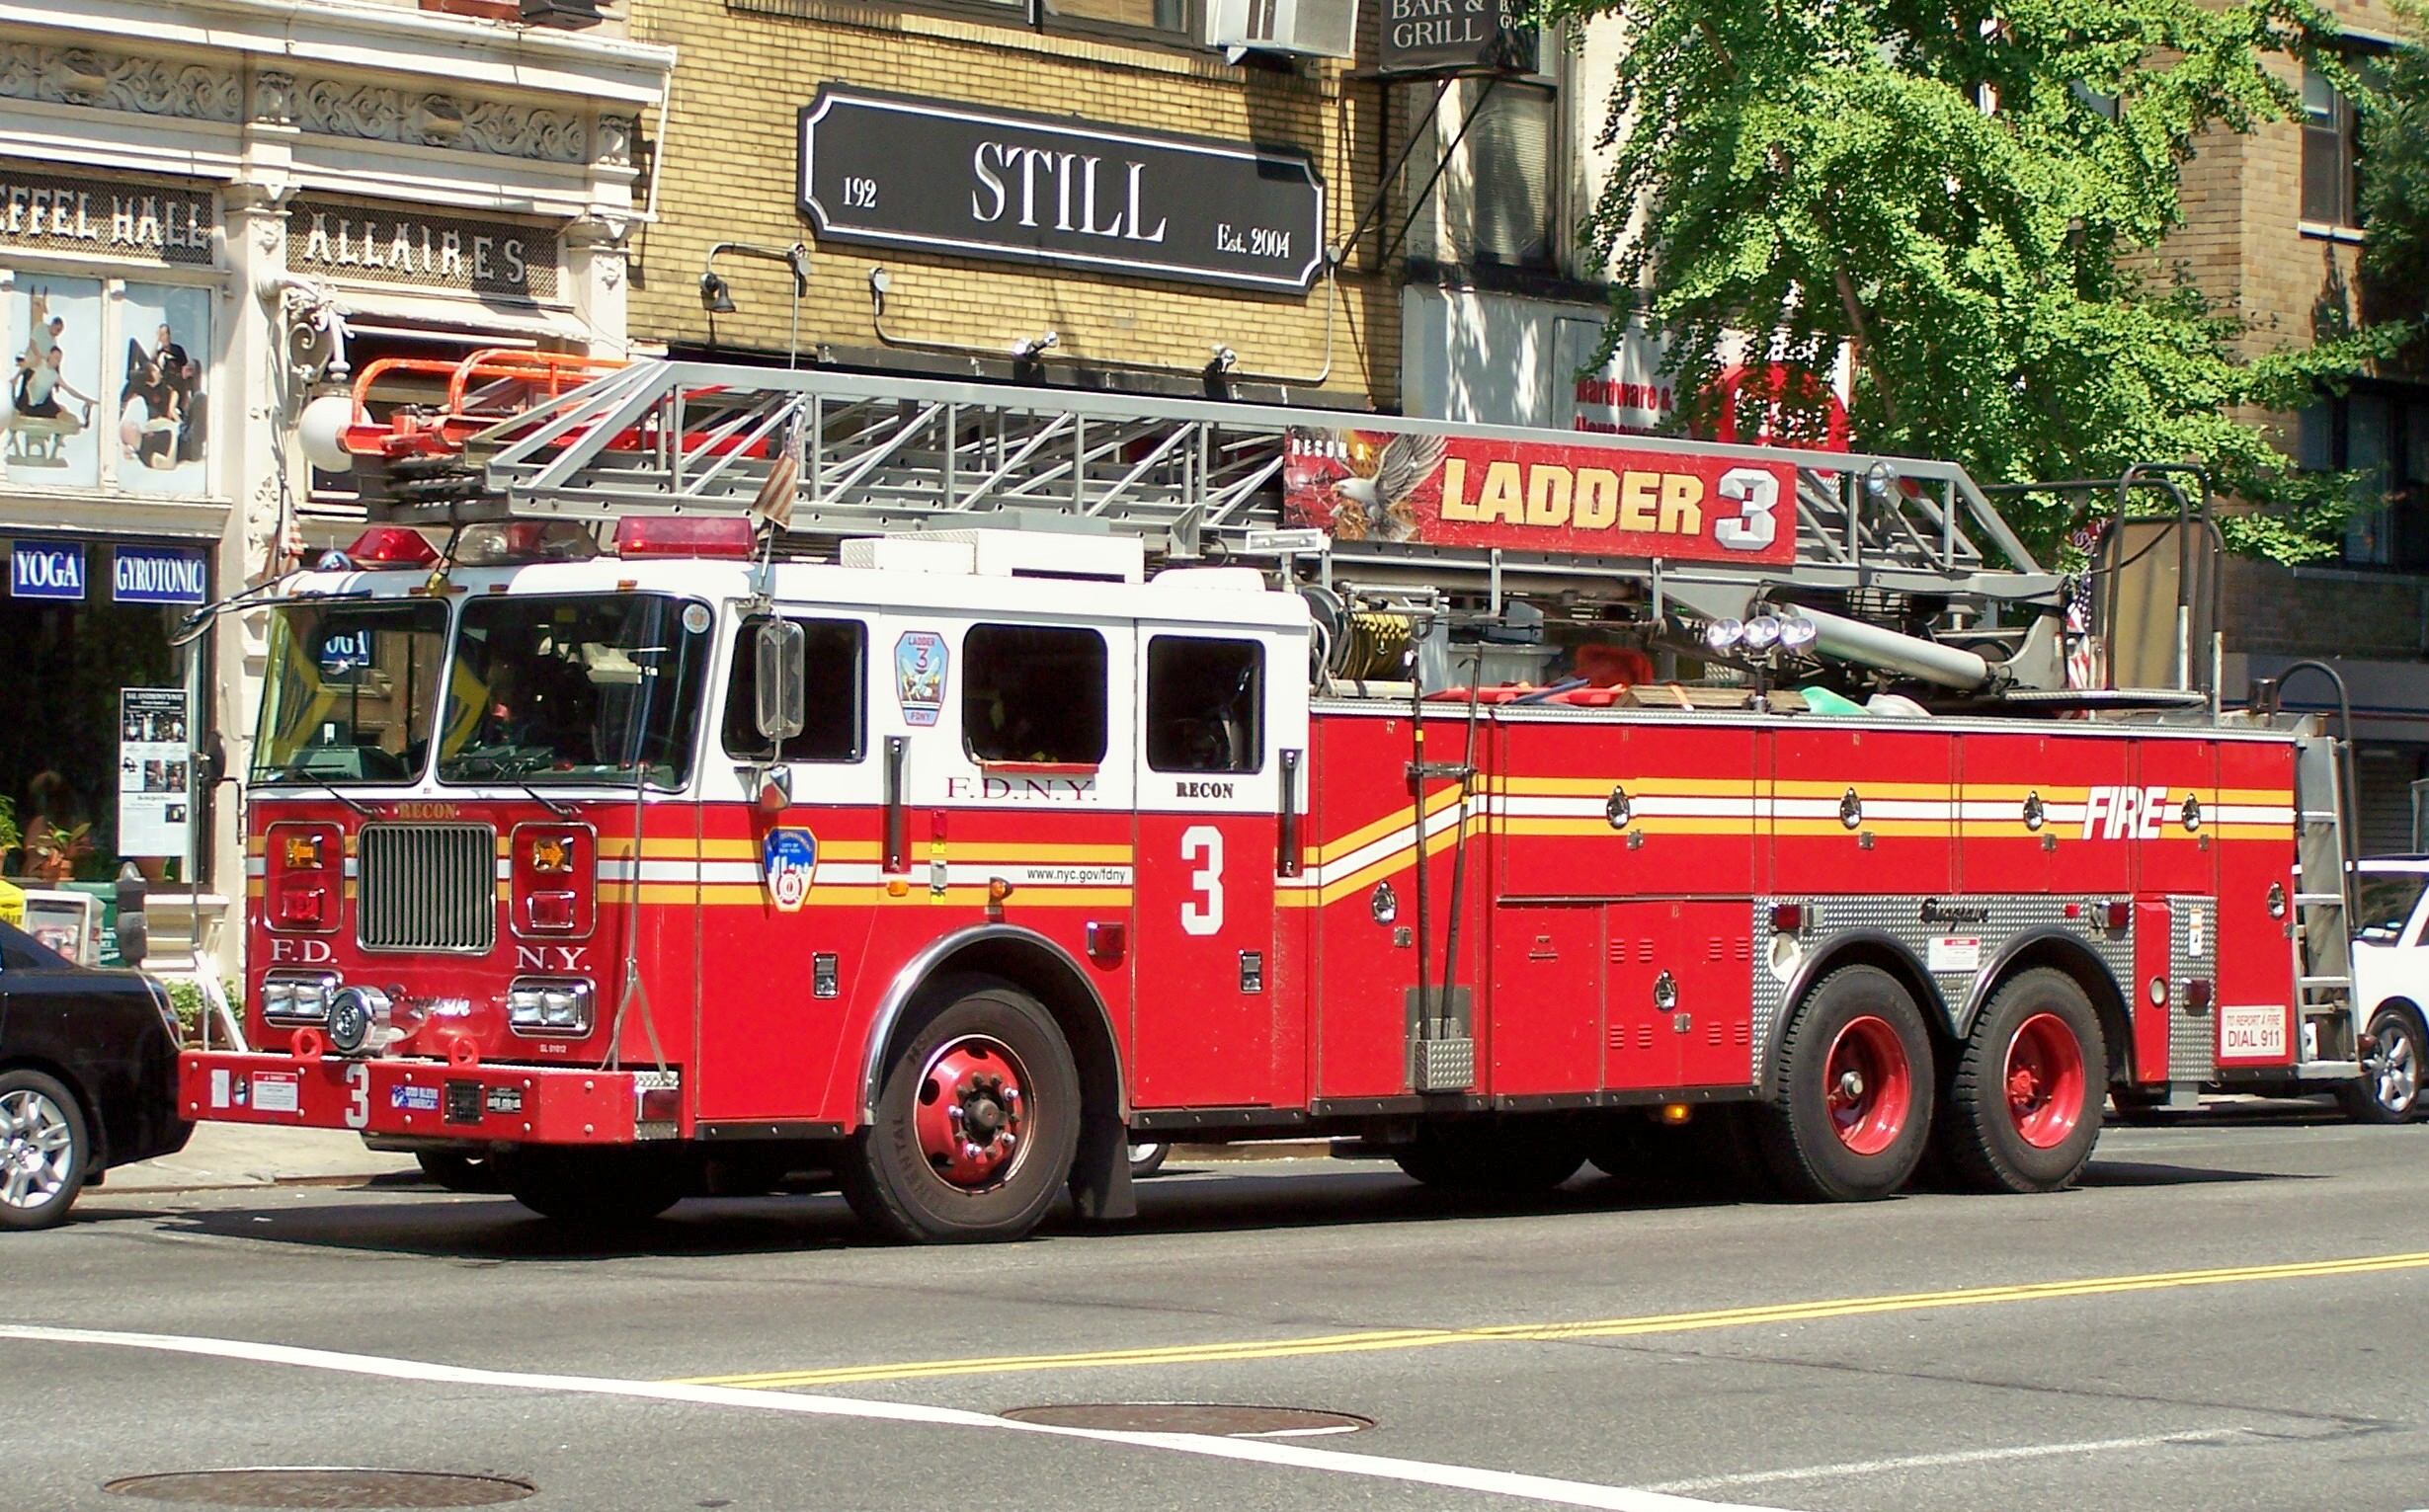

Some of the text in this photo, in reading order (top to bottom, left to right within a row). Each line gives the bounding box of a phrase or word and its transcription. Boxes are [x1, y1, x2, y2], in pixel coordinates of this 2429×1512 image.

[1393, 17, 1484, 49] GRILL
[843, 177, 877, 208] 192
[971, 140, 1168, 244] STILL
[111, 194, 208, 247] HALL
[302, 211, 526, 284] ALLAIRES
[1216, 223, 1291, 259] Est. 2004
[1291, 438, 1348, 459] RECON
[1440, 457, 1780, 551] LADDER 3
[16, 550, 80, 587] YOGA
[117, 556, 203, 593] GYROTONIC
[915, 647, 930, 670] 3
[945, 776, 1098, 802] F.D.N.Y.
[1175, 781, 1234, 799] RECON
[398, 802, 456, 819] RECON
[2081, 786, 2168, 839] FIRE
[1027, 868, 1126, 883] www.nyc.gov/fdny
[1181, 826, 1224, 935] 3
[271, 938, 593, 972] F.D. N.Y.
[2236, 1014, 2261, 1026] REPORT
[2267, 1013, 2282, 1025] FIRE
[2228, 1029, 2280, 1047] DIAL 911
[346, 1063, 369, 1128] 3
